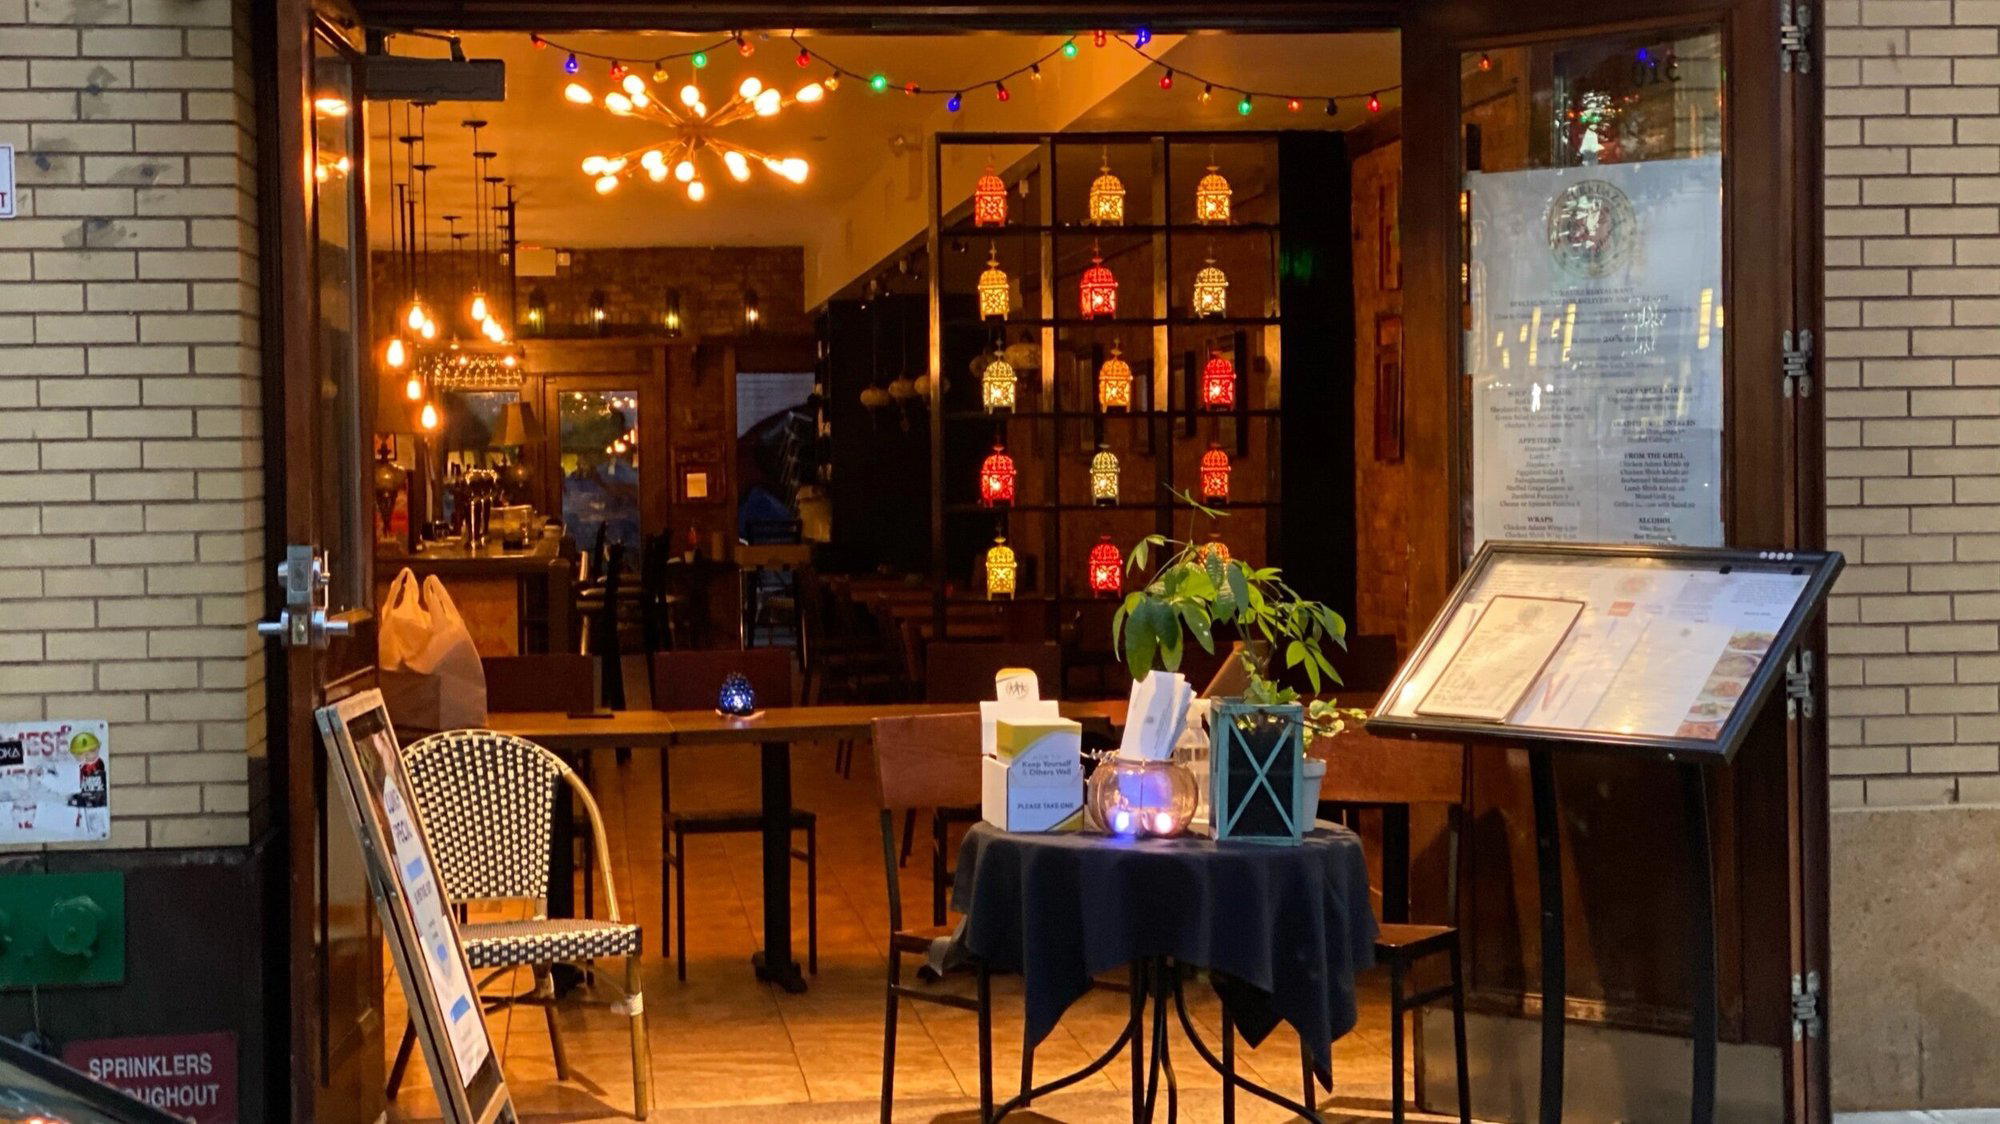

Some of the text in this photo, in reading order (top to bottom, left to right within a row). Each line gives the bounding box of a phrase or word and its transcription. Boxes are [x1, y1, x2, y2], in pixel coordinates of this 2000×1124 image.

[1022, 759, 1072, 769] Keep Yourself
[1029, 768, 1054, 776] Others
[1055, 768, 1072, 776] Well
[1060, 801, 1075, 809] ONE
[89, 1053, 213, 1080] SPRINKLERS
